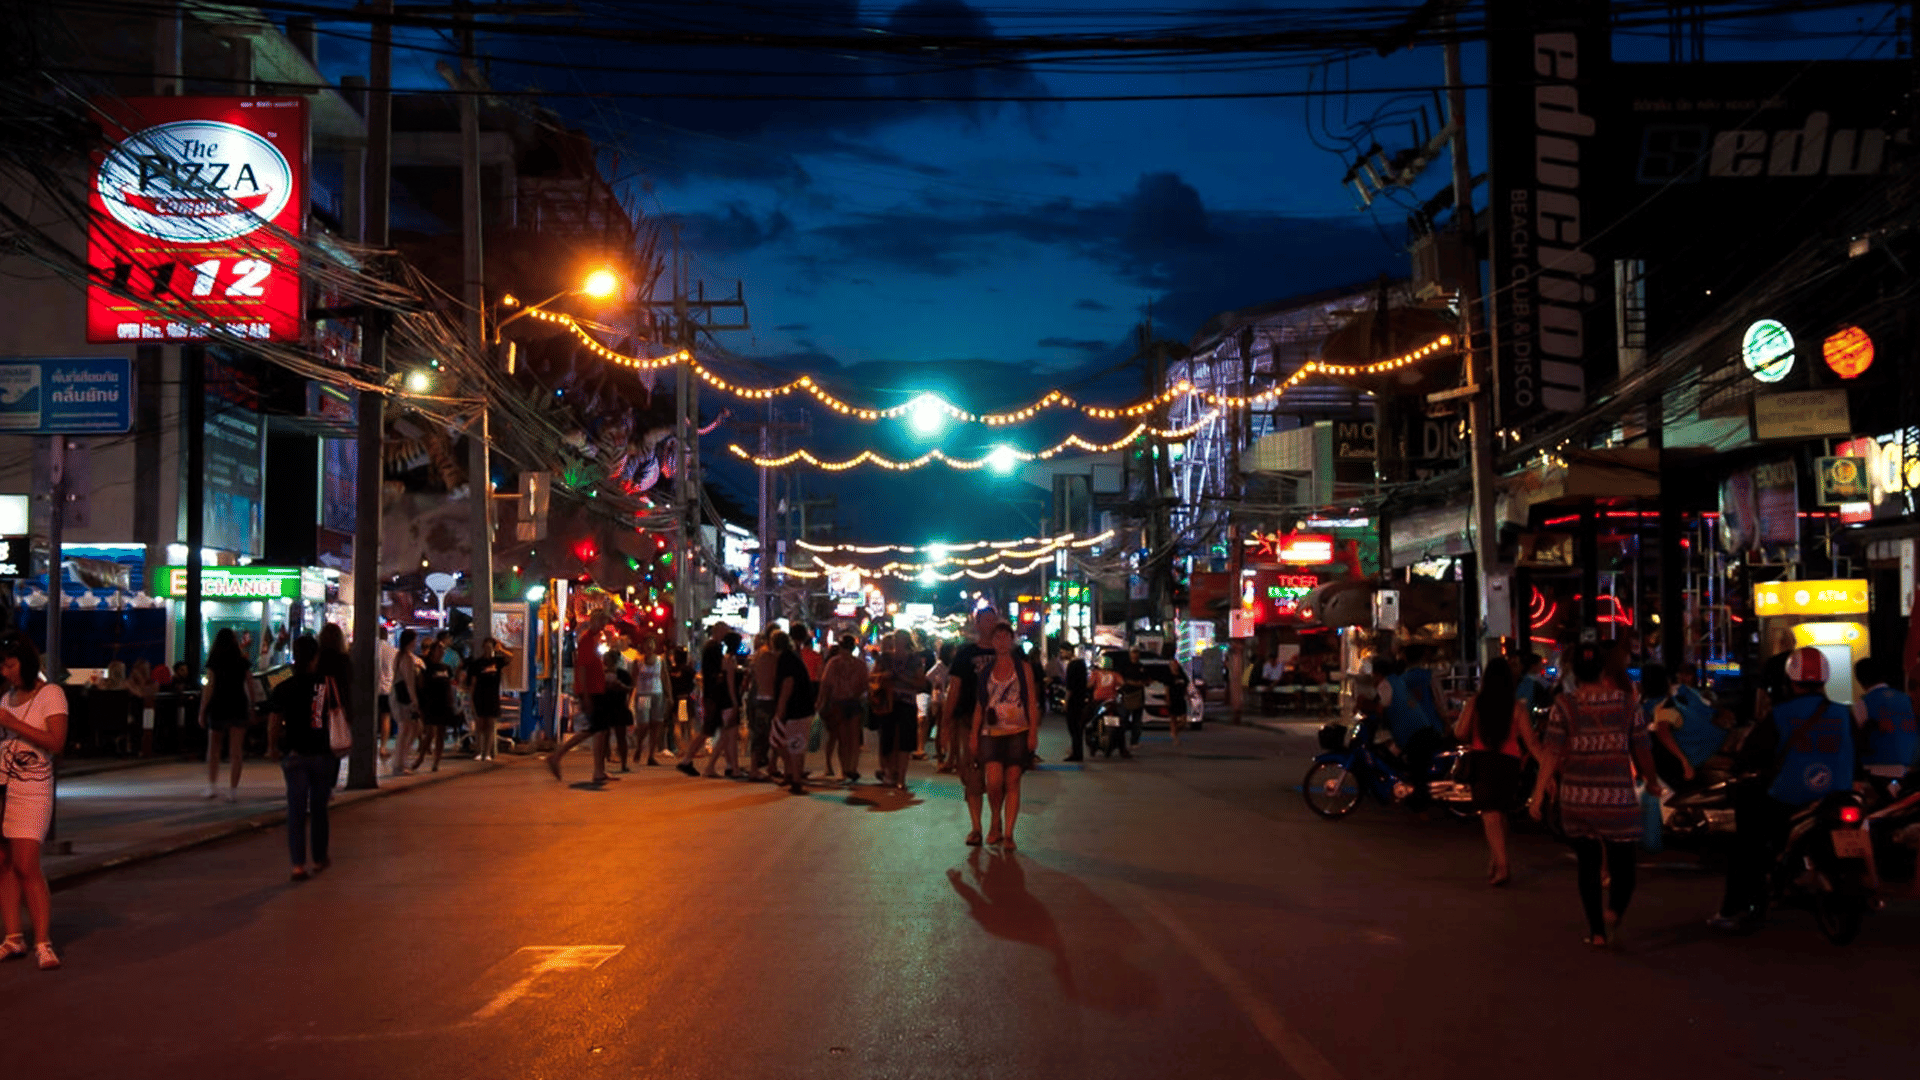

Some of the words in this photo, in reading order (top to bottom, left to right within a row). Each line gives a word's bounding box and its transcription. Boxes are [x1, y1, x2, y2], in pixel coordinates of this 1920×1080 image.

[182, 139, 217, 159] The
[138, 155, 260, 193] PIZZA
[1510, 188, 1530, 259] BEACH
[1511, 263, 1531, 317] CLUB
[1513, 342, 1534, 407] DISCO
[170, 569, 282, 596] ECHANGE
